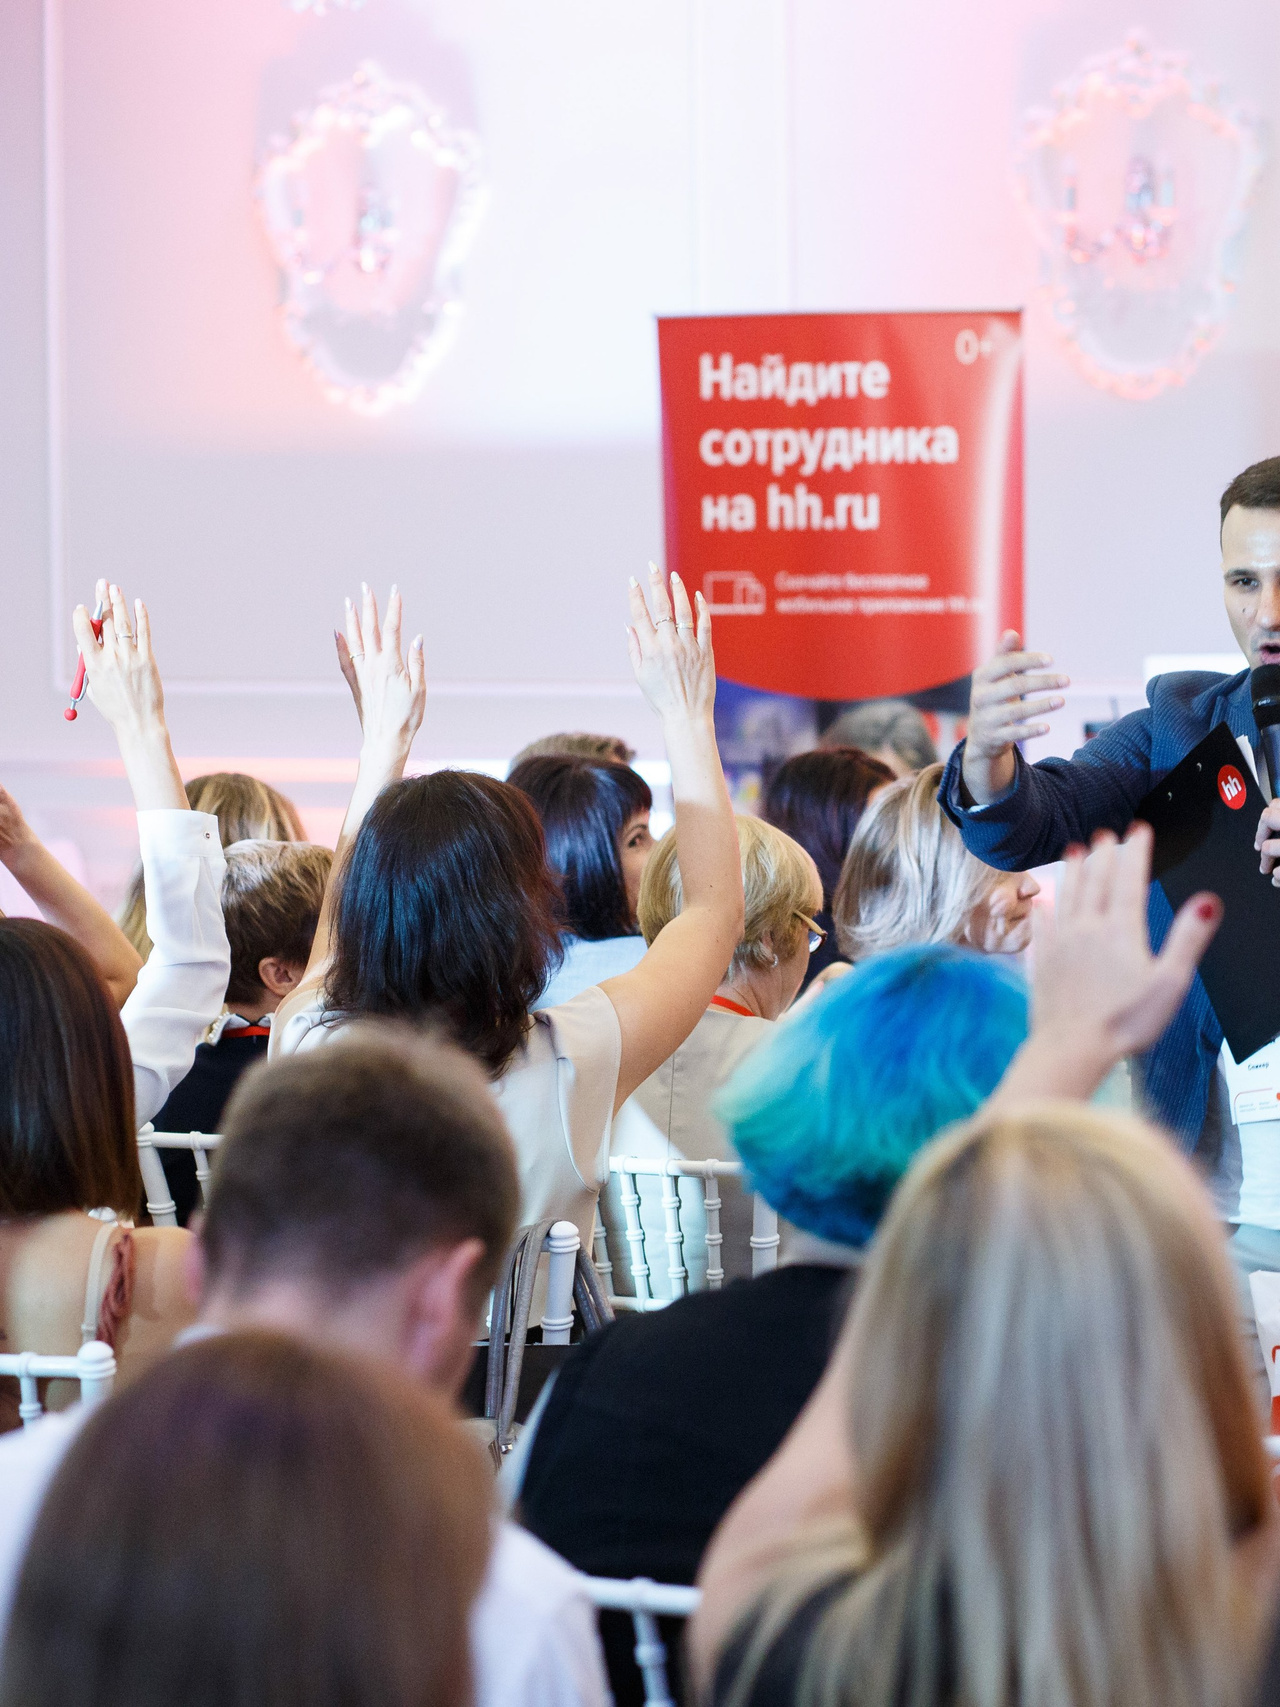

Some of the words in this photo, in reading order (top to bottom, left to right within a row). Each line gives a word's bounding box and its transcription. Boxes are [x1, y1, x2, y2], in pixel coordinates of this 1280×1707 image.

[699, 351, 891, 408] Найдите
[699, 424, 960, 477] сотрудника
[700, 493, 757, 532] на
[766, 482, 880, 532] hh.ru
[1221, 774, 1242, 801] hh
